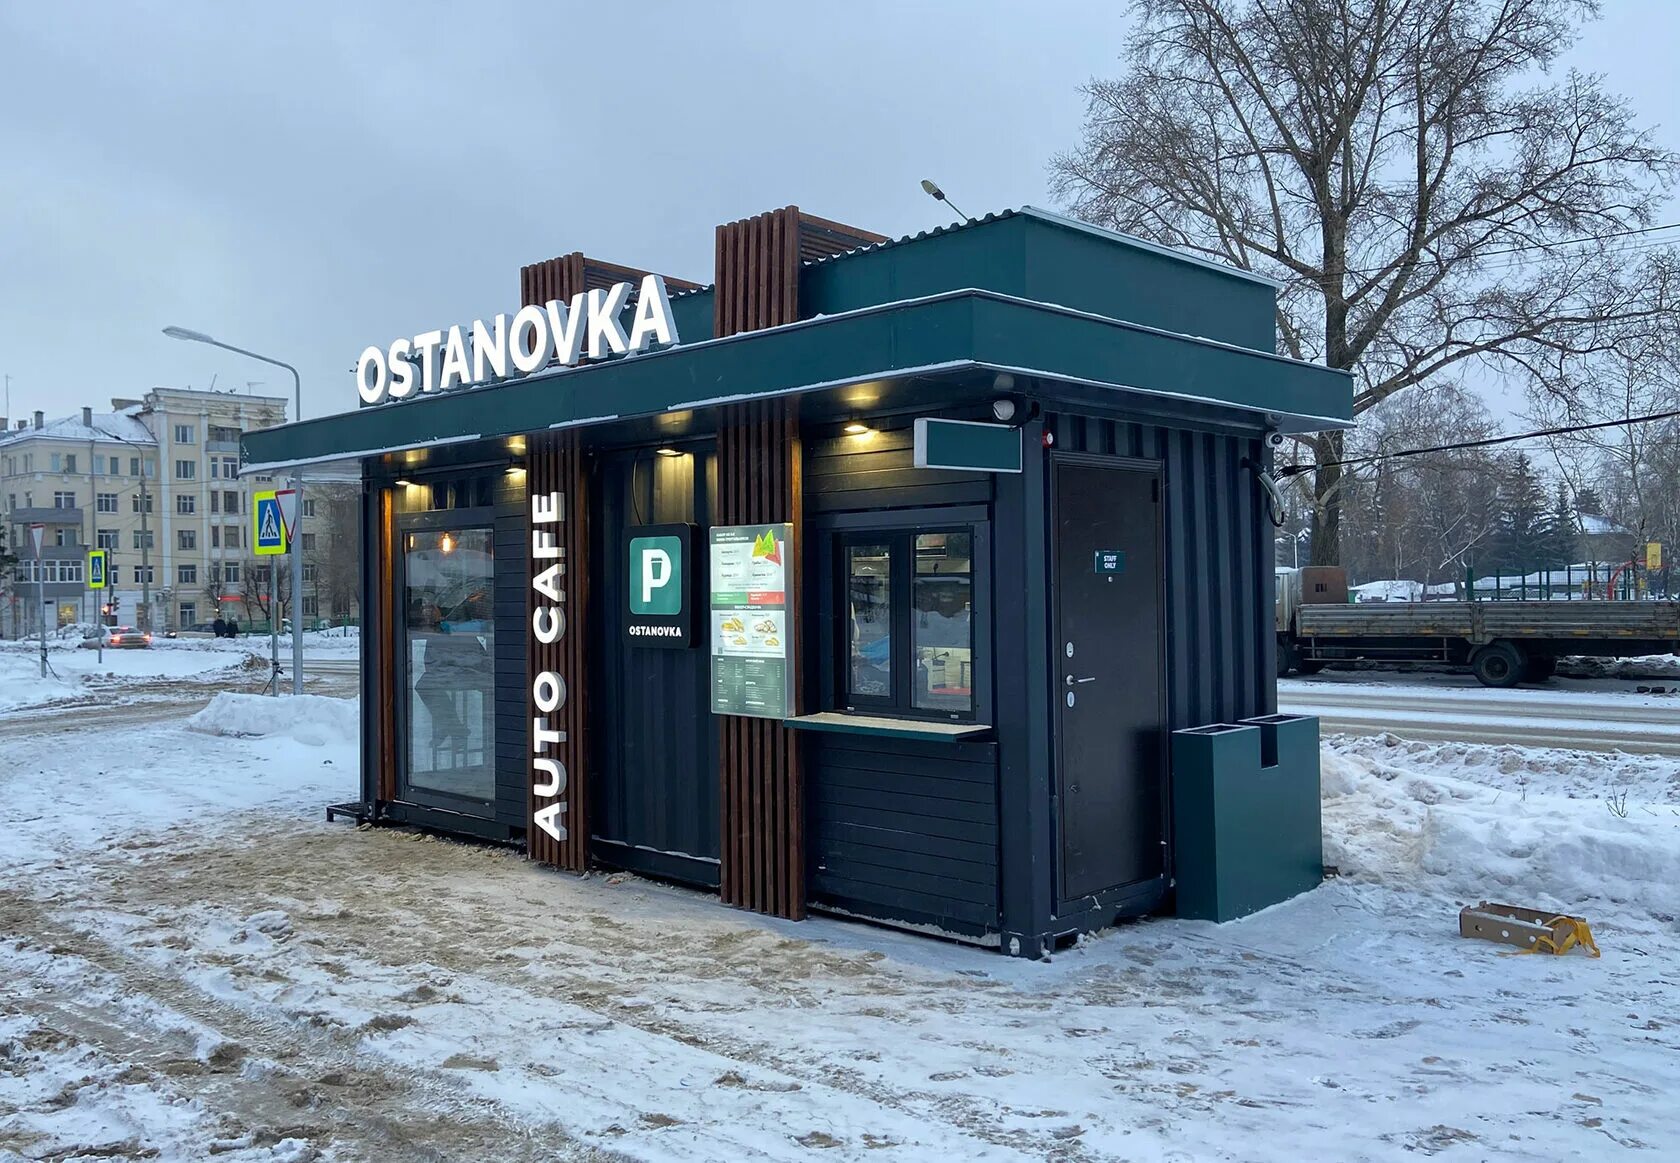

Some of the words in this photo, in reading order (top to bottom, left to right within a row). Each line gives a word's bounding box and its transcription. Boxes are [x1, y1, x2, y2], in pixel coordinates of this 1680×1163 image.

[356, 274, 678, 404] OSTANOVKA
[532, 491, 565, 644] CAFE
[628, 625, 682, 637] OSTANOVKA
[642, 548, 672, 603] P
[533, 671, 566, 842] AUTO
